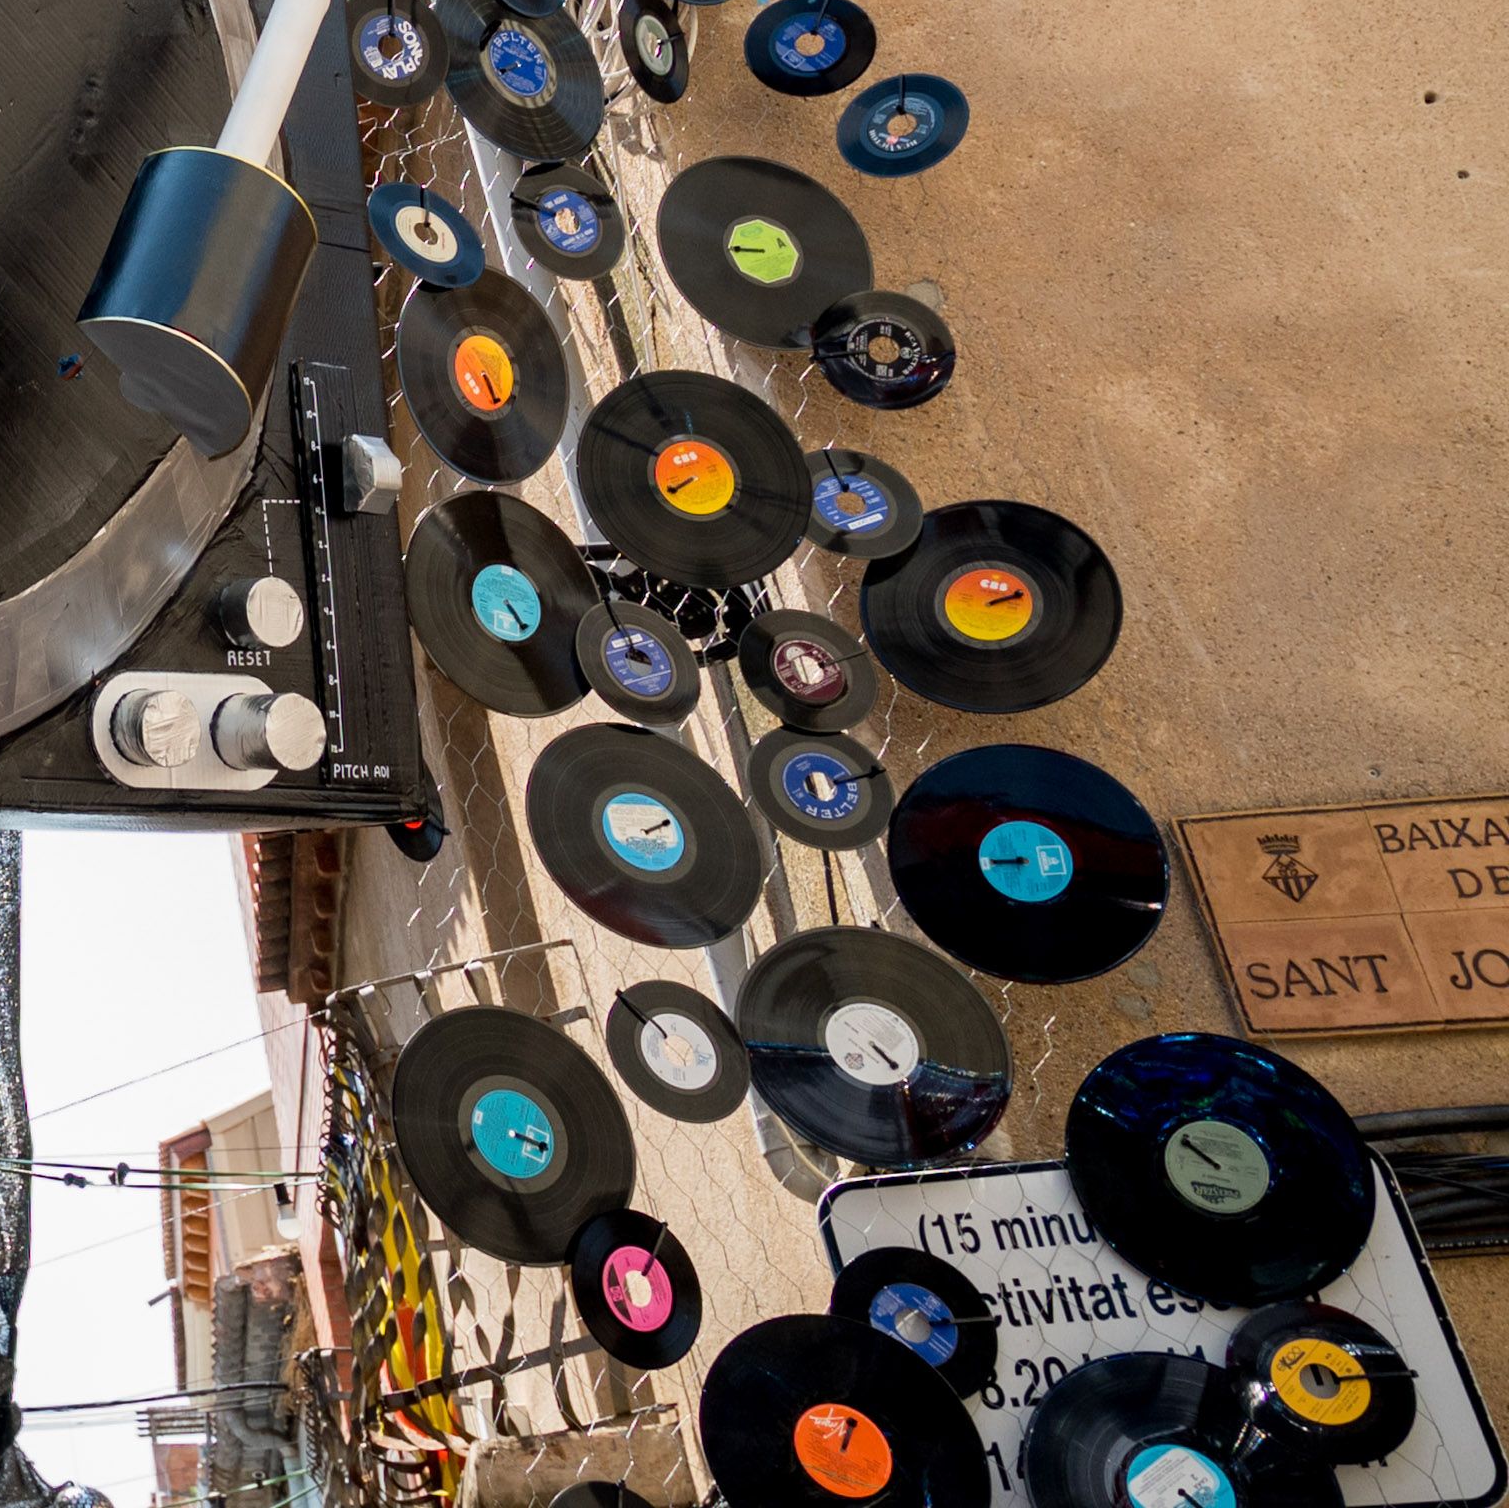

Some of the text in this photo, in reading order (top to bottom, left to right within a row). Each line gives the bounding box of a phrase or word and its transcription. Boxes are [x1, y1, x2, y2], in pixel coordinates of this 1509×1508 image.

[493, 30, 545, 64] BELTER
[673, 450, 698, 466] CBS
[979, 578, 1009, 592] CBS
[227, 648, 272, 668] RESET
[333, 762, 370, 780] PITCH
[804, 782, 859, 819] BELTER
[1373, 816, 1509, 853] BAIXA
[1446, 865, 1509, 899] DE
[1246, 948, 1509, 1000] SANT JO
[918, 1205, 1098, 1255] (15 minu
[978, 1273, 1137, 1328] ctivitat
